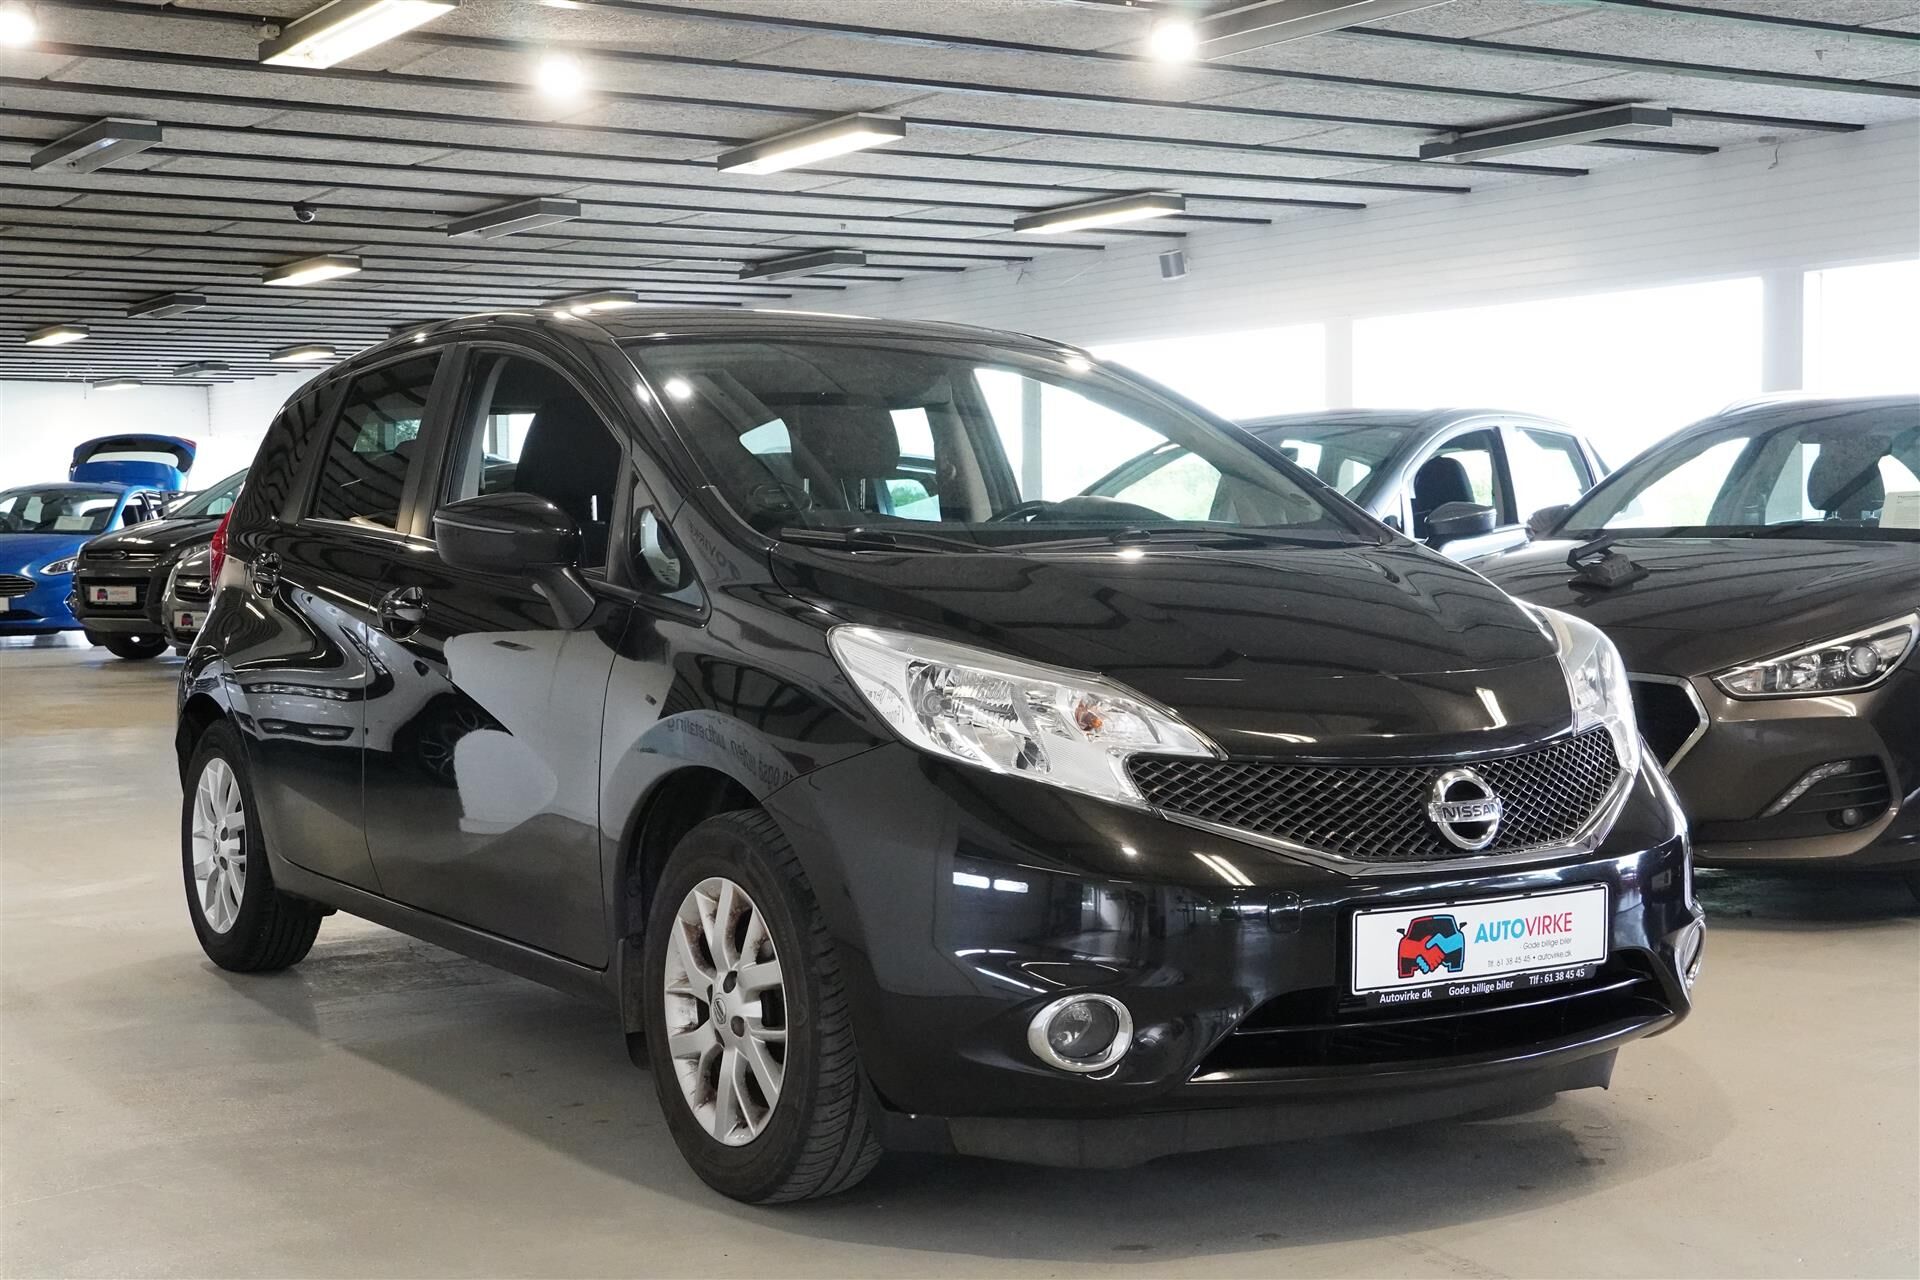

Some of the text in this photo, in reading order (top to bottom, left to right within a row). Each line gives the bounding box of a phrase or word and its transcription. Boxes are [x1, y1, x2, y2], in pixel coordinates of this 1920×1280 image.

[1442, 803, 1502, 818] NISSAN
[1474, 912, 1573, 943] AUTOVIRKE
[1523, 939, 1540, 950] Gode
[1541, 937, 1558, 949] billige
[1544, 972, 1554, 983] 61
[1555, 971, 1565, 982] 38
[1565, 969, 1575, 980] 45
[1575, 968, 1585, 979] 45
[1448, 979, 1514, 996] Gode billige biler
[1379, 988, 1433, 1004] Autovirke dk
